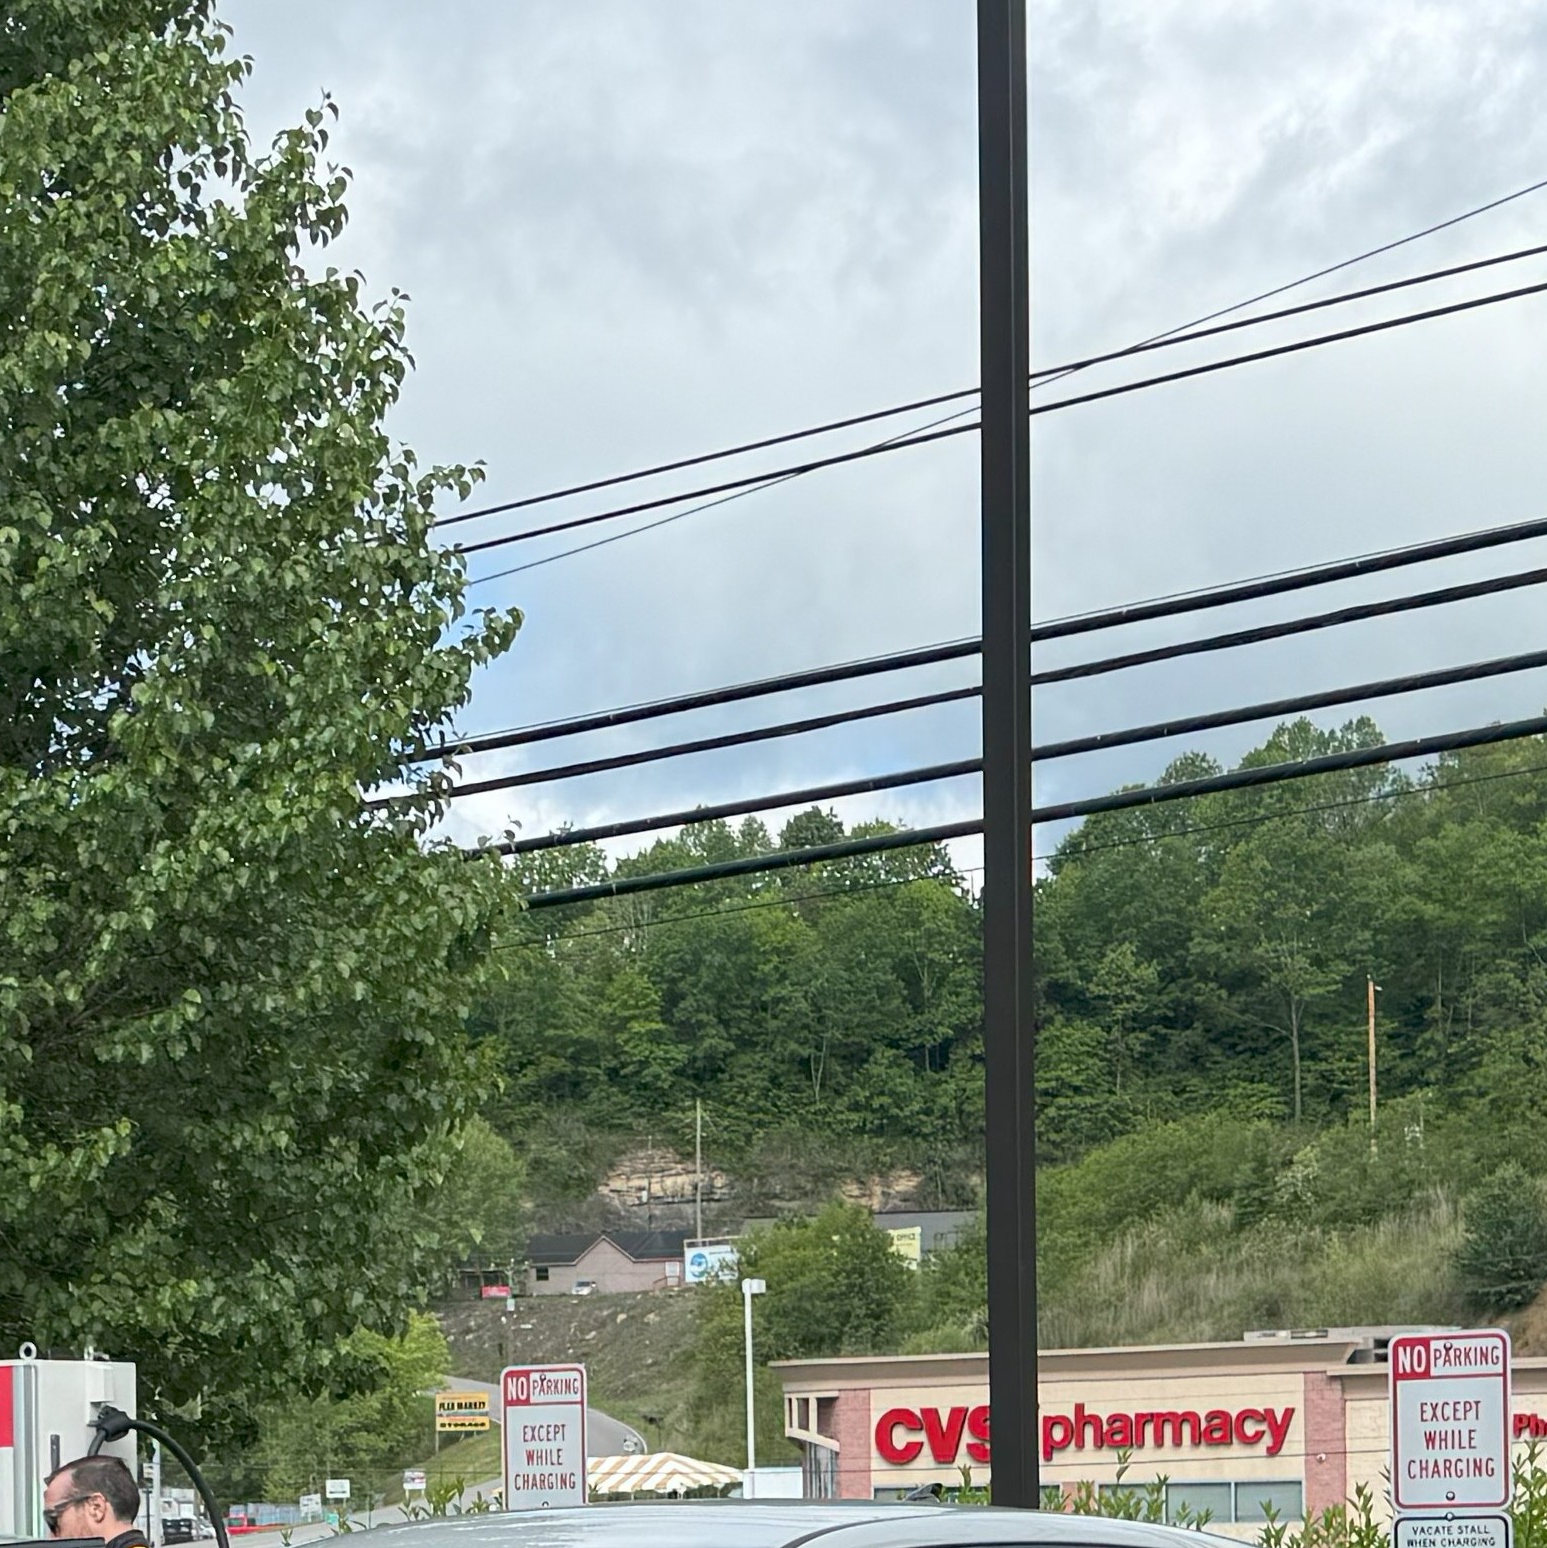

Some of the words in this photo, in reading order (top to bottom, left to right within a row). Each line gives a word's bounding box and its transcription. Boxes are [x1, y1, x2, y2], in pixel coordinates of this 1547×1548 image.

[1397, 1345, 1427, 1374] NO
[1433, 1345, 1500, 1368] PARKING
[507, 1377, 528, 1401] NO
[532, 1377, 580, 1397] PARKING
[1420, 1400, 1481, 1422] EXCEPT
[522, 1424, 567, 1443] EXCEPT
[1042, 1403, 1295, 1461] pharmacy
[1424, 1429, 1477, 1451] WHILE
[525, 1448, 564, 1467] WHILE
[1407, 1457, 1495, 1480] CHARGING
[514, 1472, 576, 1491] CHARGING
[1412, 1525, 1452, 1536] VACATE
[1457, 1524, 1490, 1535] STALL
[1407, 1538, 1436, 1548] WHEN
[1440, 1537, 1496, 1548] CHARGING
